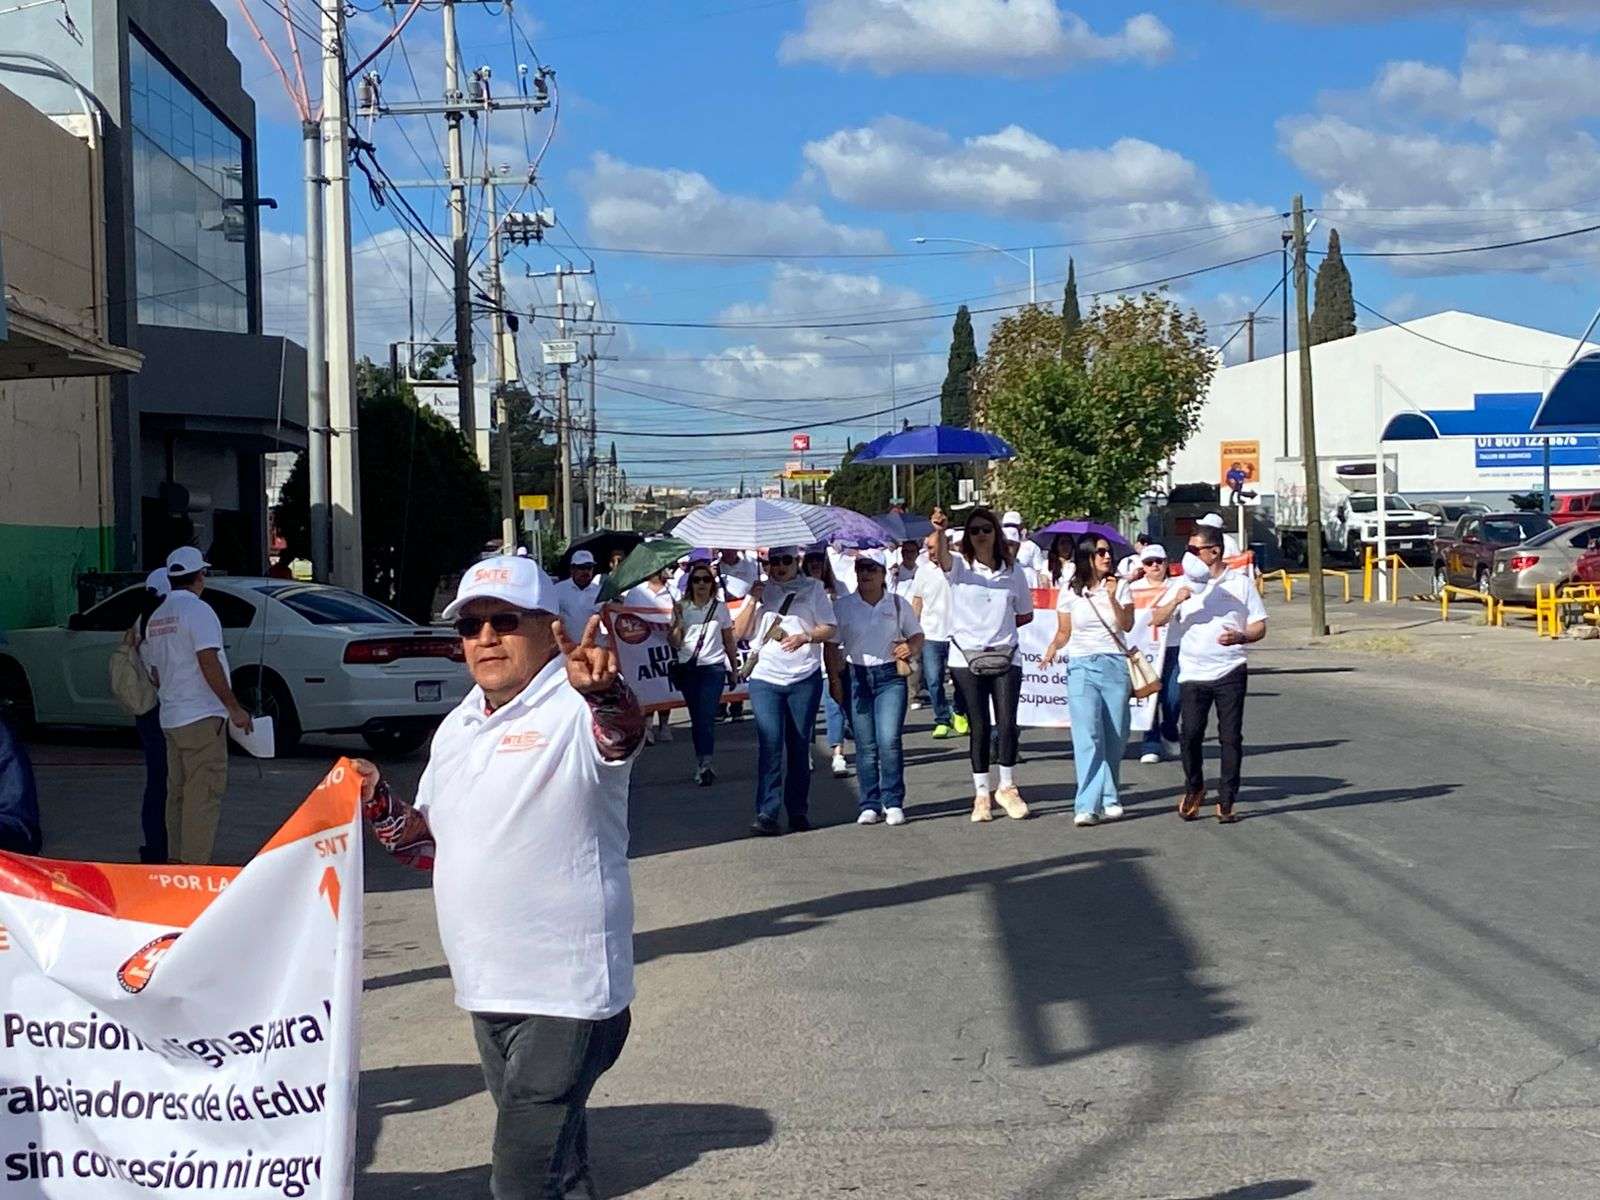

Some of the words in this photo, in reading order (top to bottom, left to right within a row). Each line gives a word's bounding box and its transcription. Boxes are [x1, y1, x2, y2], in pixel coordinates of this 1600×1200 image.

[192, 1084, 222, 1121] de
[226, 1084, 254, 1121] la
[5, 1142, 64, 1181] sin
[222, 1148, 253, 1188] ni
